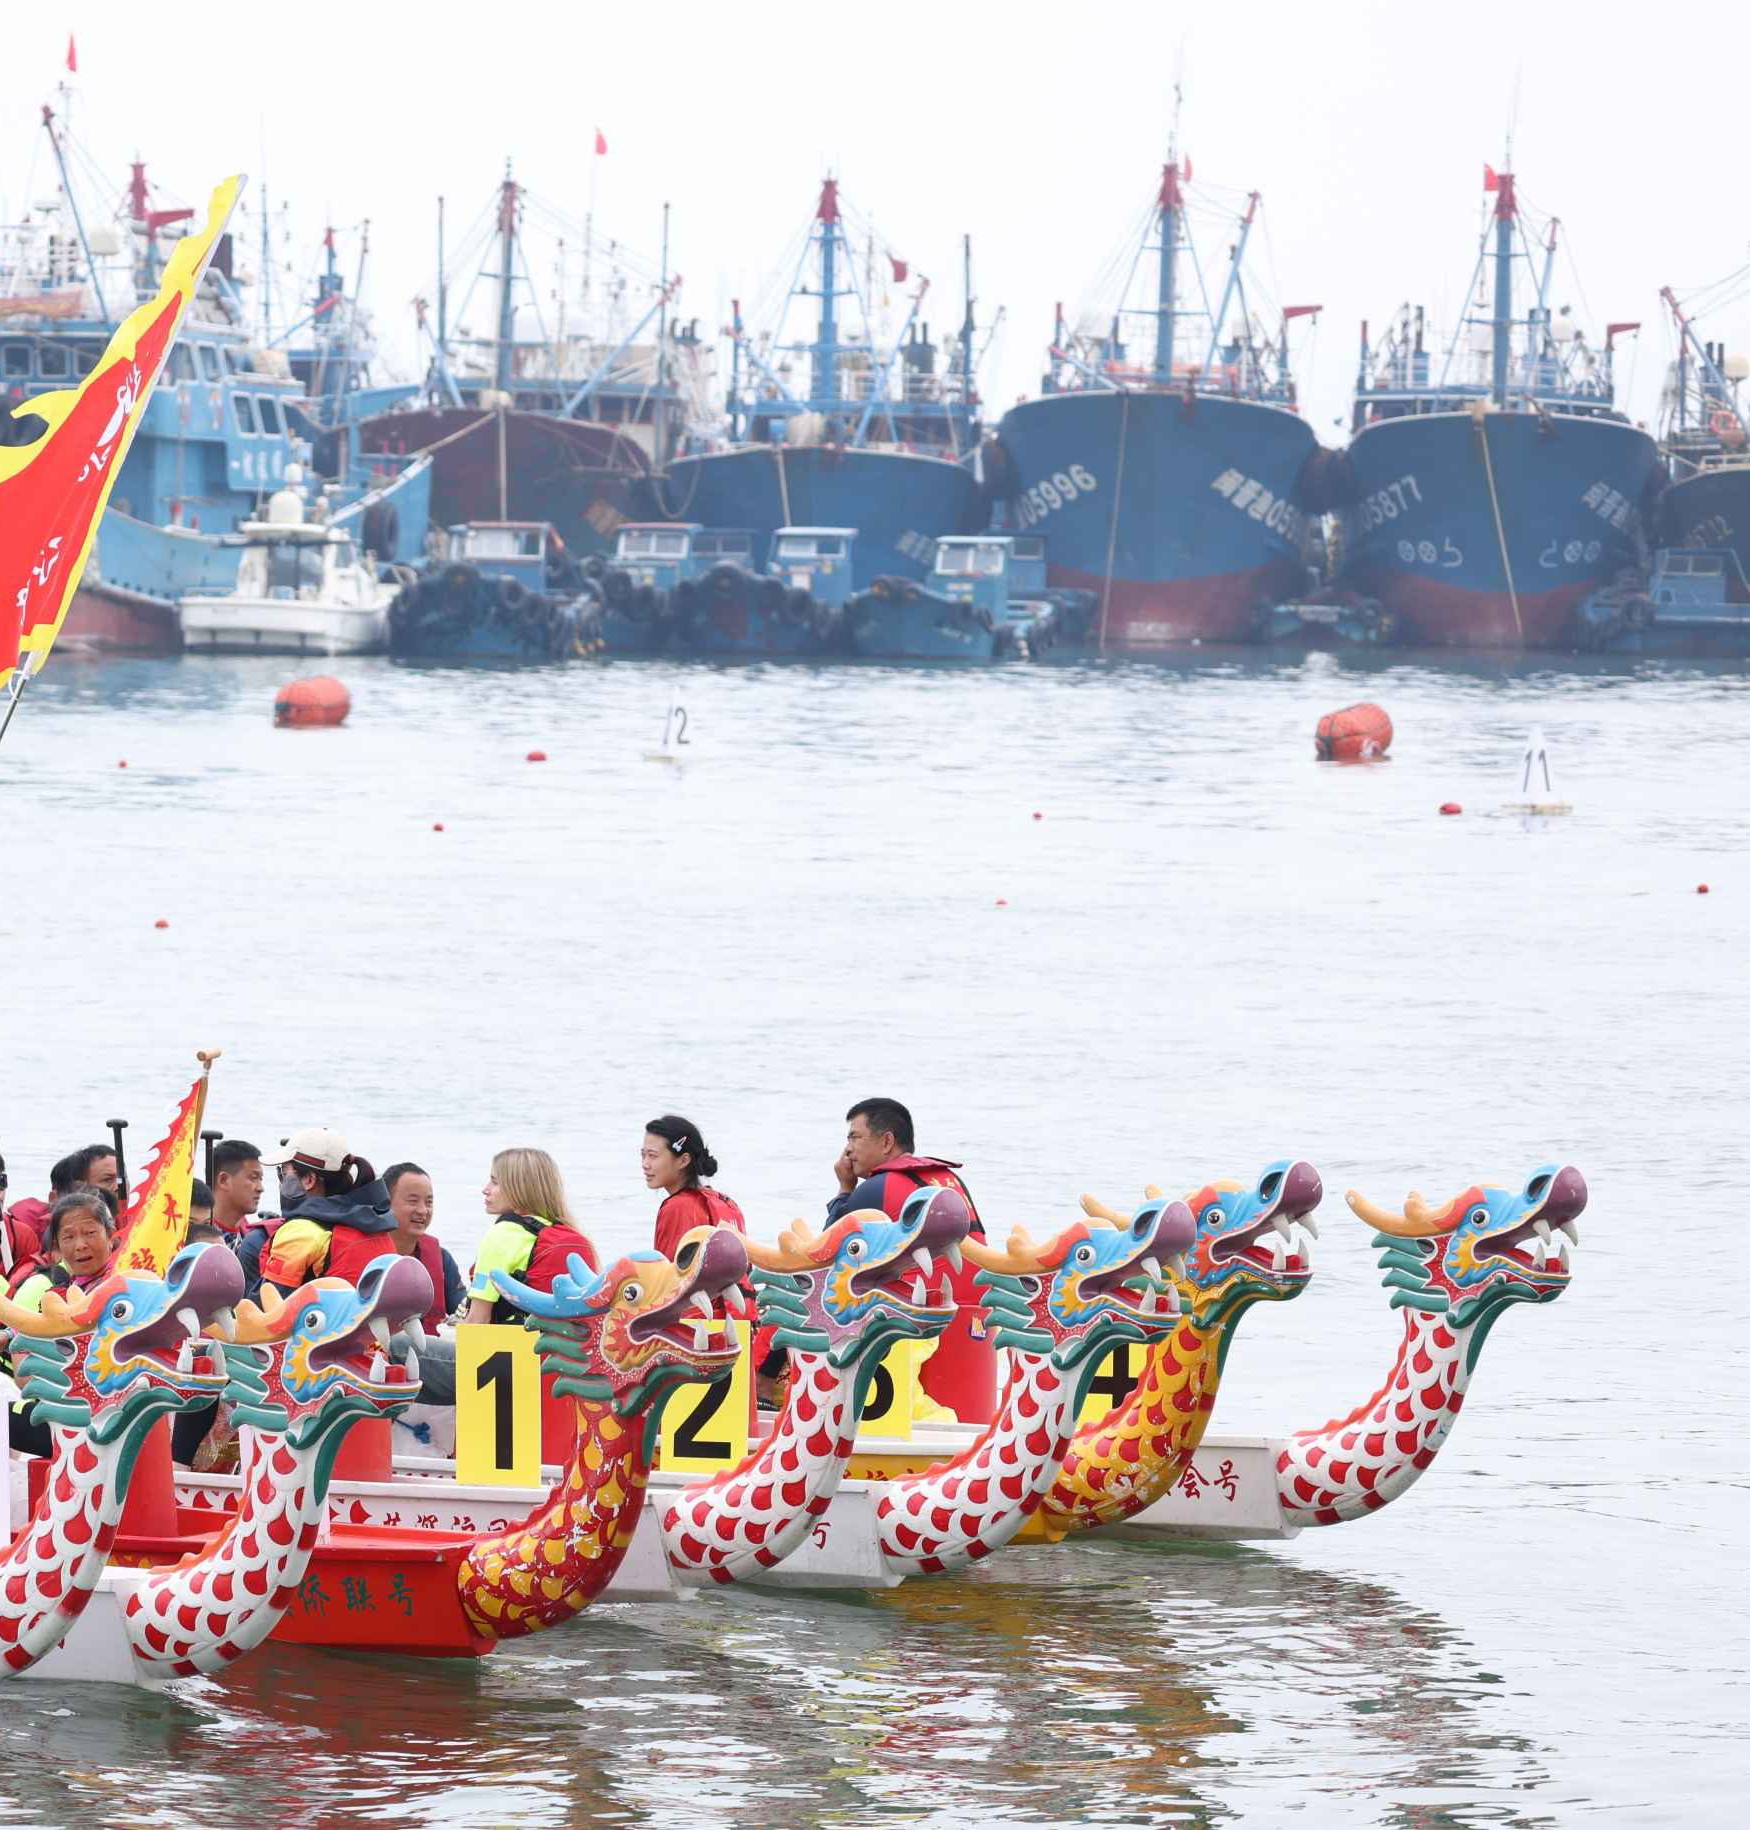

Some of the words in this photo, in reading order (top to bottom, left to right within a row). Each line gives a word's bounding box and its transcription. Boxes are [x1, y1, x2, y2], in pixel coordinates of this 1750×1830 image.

[476, 1352, 513, 1470] 1
[674, 1368, 732, 1460] 2
[1166, 1459, 1239, 1502] 会号
[284, 1573, 413, 1616] 侨联号
